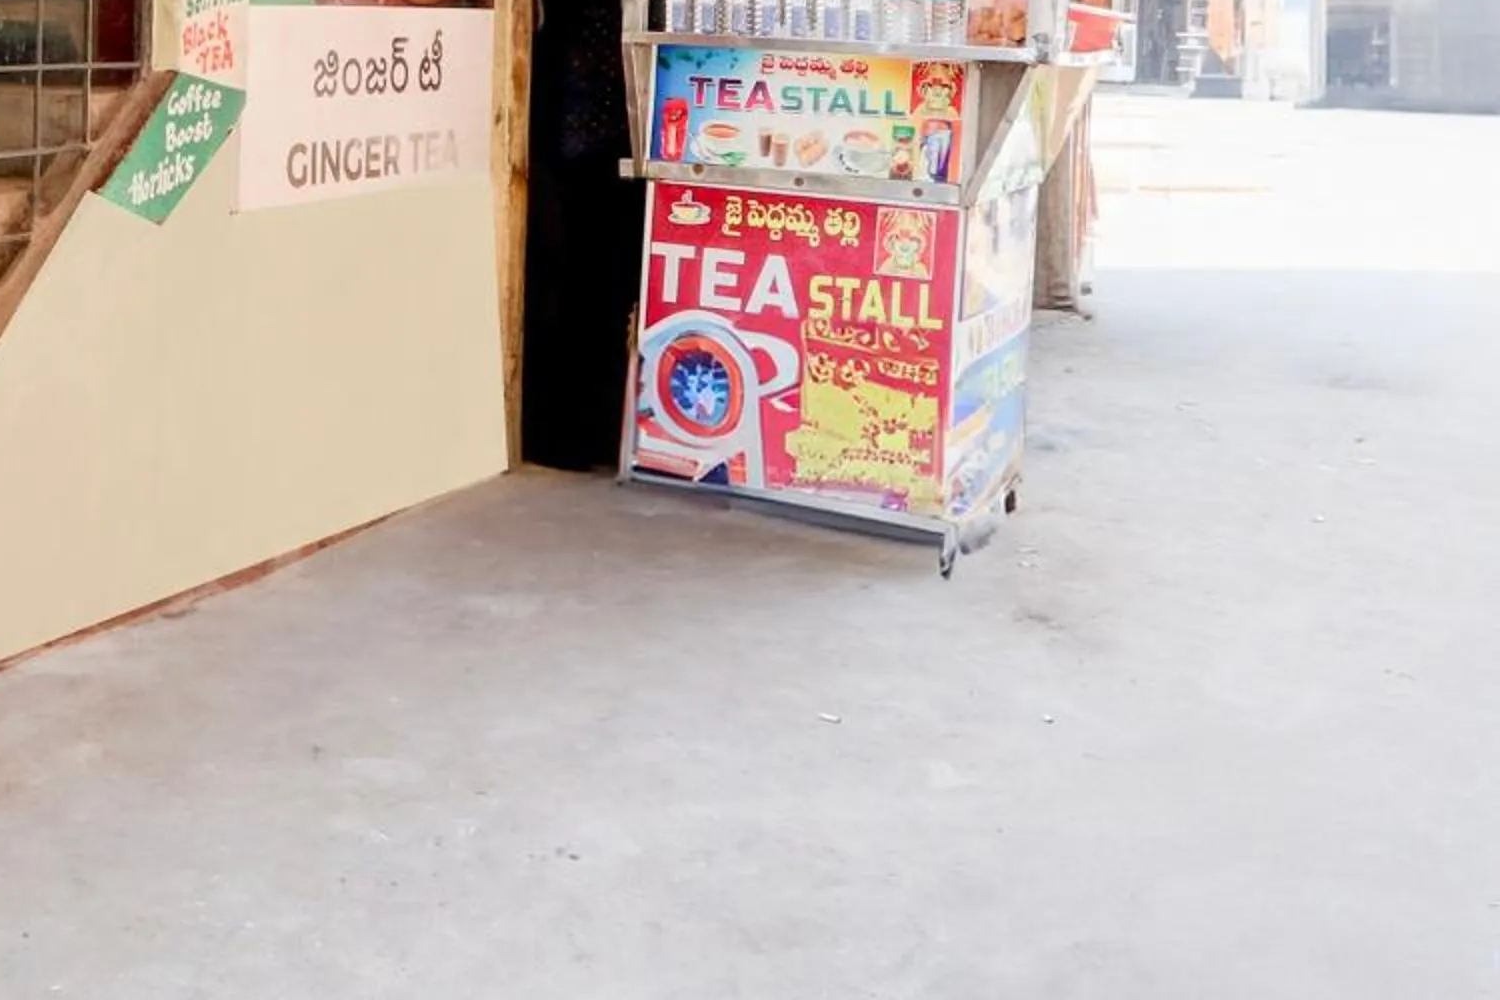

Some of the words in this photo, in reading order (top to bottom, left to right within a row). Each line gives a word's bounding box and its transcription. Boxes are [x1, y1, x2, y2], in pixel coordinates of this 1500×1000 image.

[313, 36, 409, 98] జింజర్
[418, 29, 444, 92] టీ
[689, 76, 776, 114] TEA
[780, 85, 907, 117] STALL
[165, 111, 212, 153] Boost
[286, 134, 401, 189] GINGER
[409, 128, 460, 174] TEA
[128, 152, 195, 206] Horlicks
[651, 241, 800, 320] TEA
[808, 274, 944, 331] STALL
